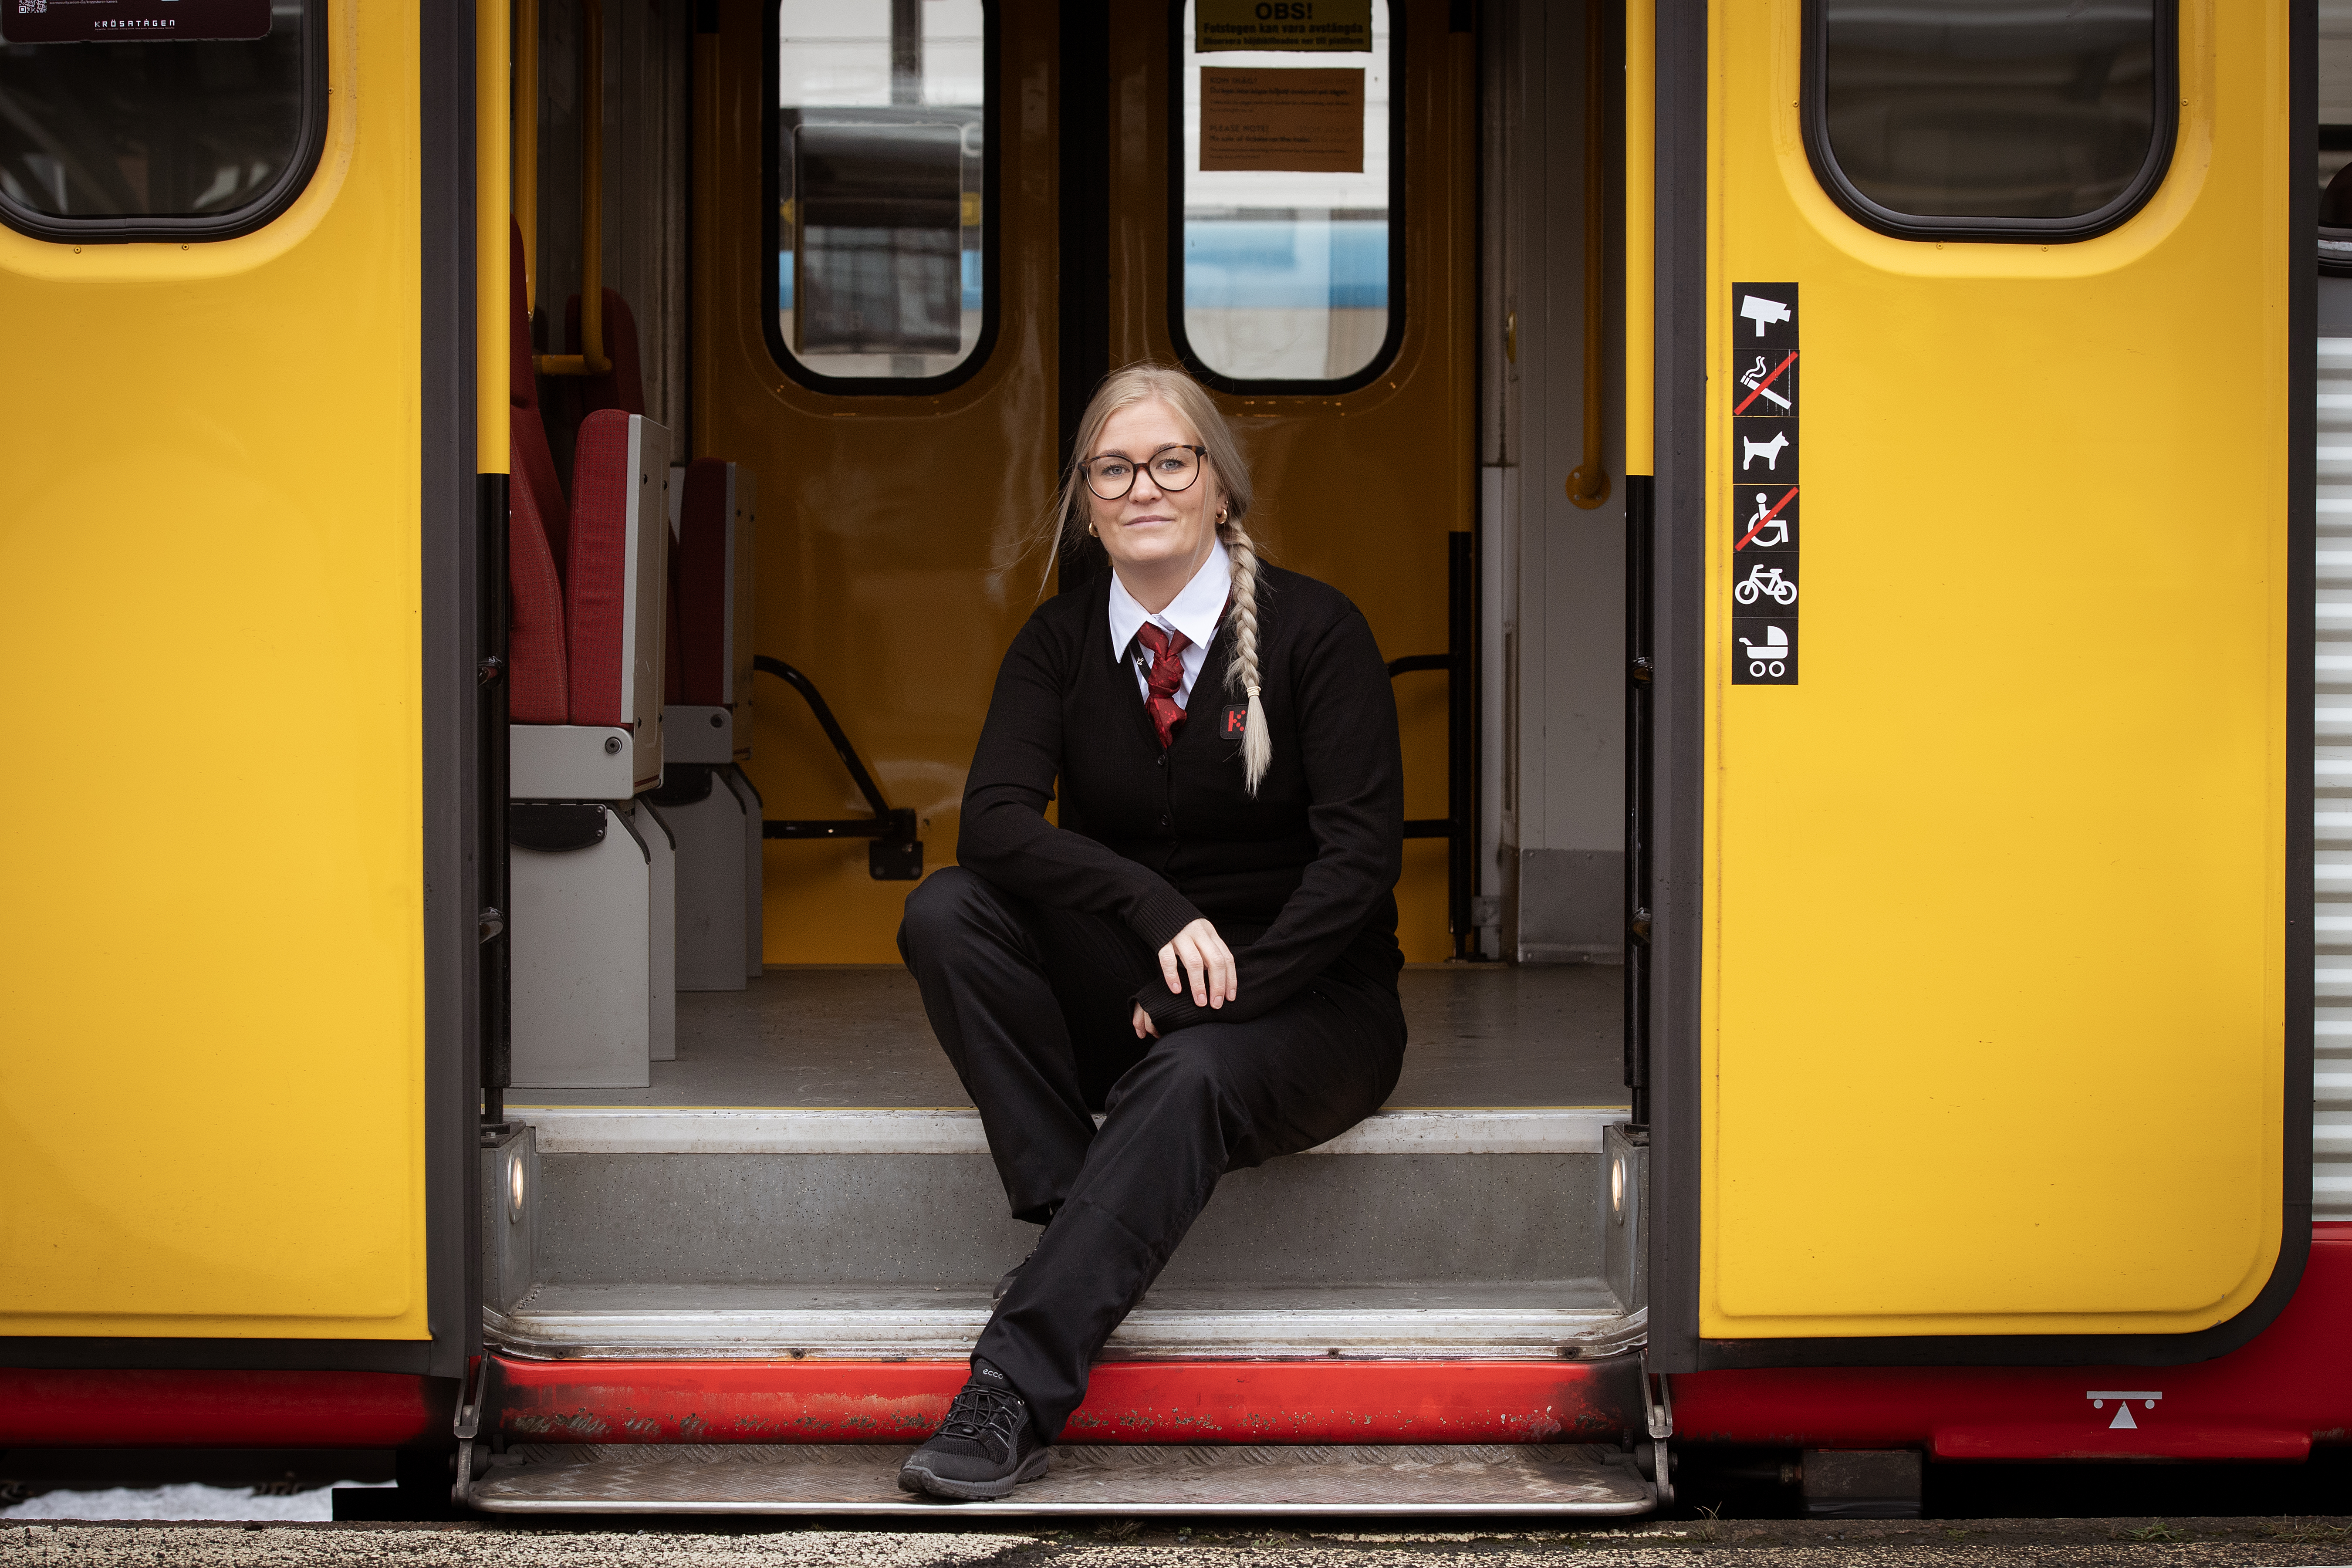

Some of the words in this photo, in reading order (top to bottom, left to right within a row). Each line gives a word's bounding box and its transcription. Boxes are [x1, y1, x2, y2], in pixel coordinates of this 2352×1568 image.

[1255, 3, 1313, 20] OBS!
[95, 19, 175, 27] KRÖSATÅGEN
[1259, 23, 1279, 33] kan
[1282, 24, 1306, 33] vara
[1228, 710, 1246, 732] K
[983, 1369, 1004, 1379] ecco
